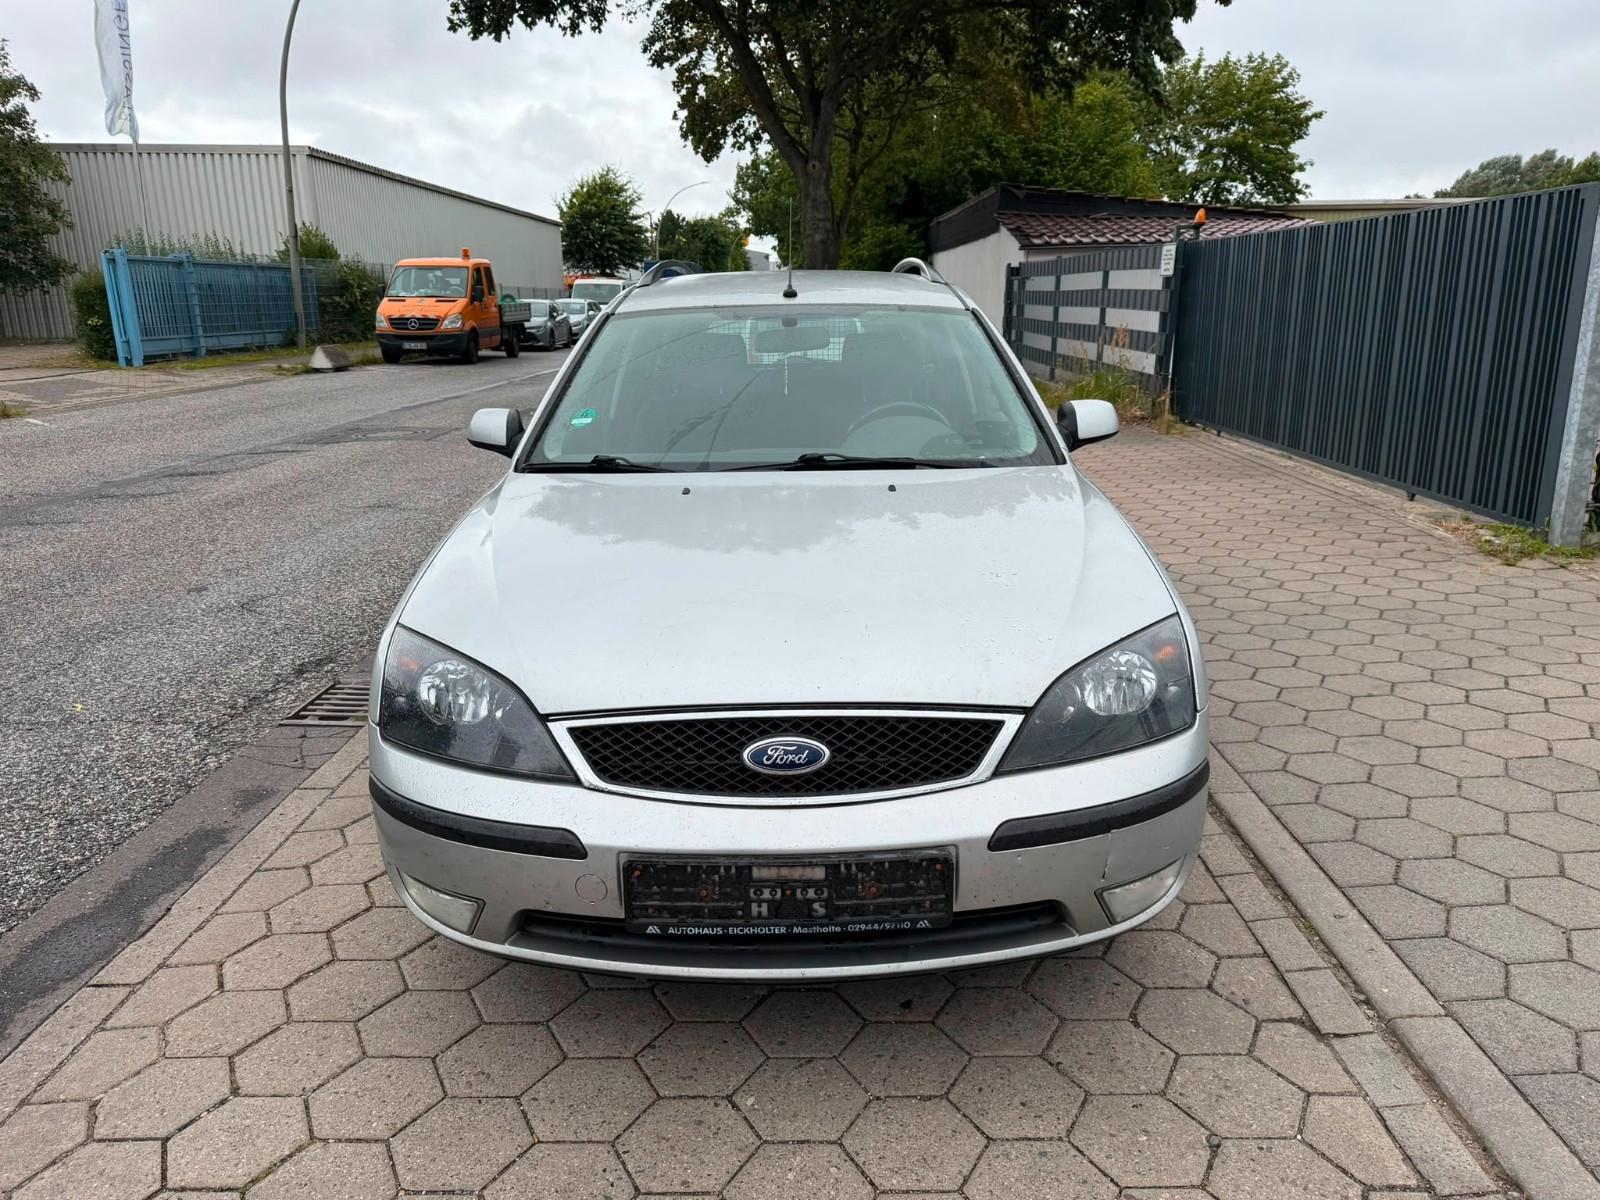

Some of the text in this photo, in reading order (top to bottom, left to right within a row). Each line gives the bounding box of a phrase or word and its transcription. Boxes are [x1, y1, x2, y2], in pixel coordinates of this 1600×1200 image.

[763, 745, 809, 765] Ford
[667, 926, 723, 935] AUTOHAUS
[728, 926, 787, 935] EICKHOLTER
